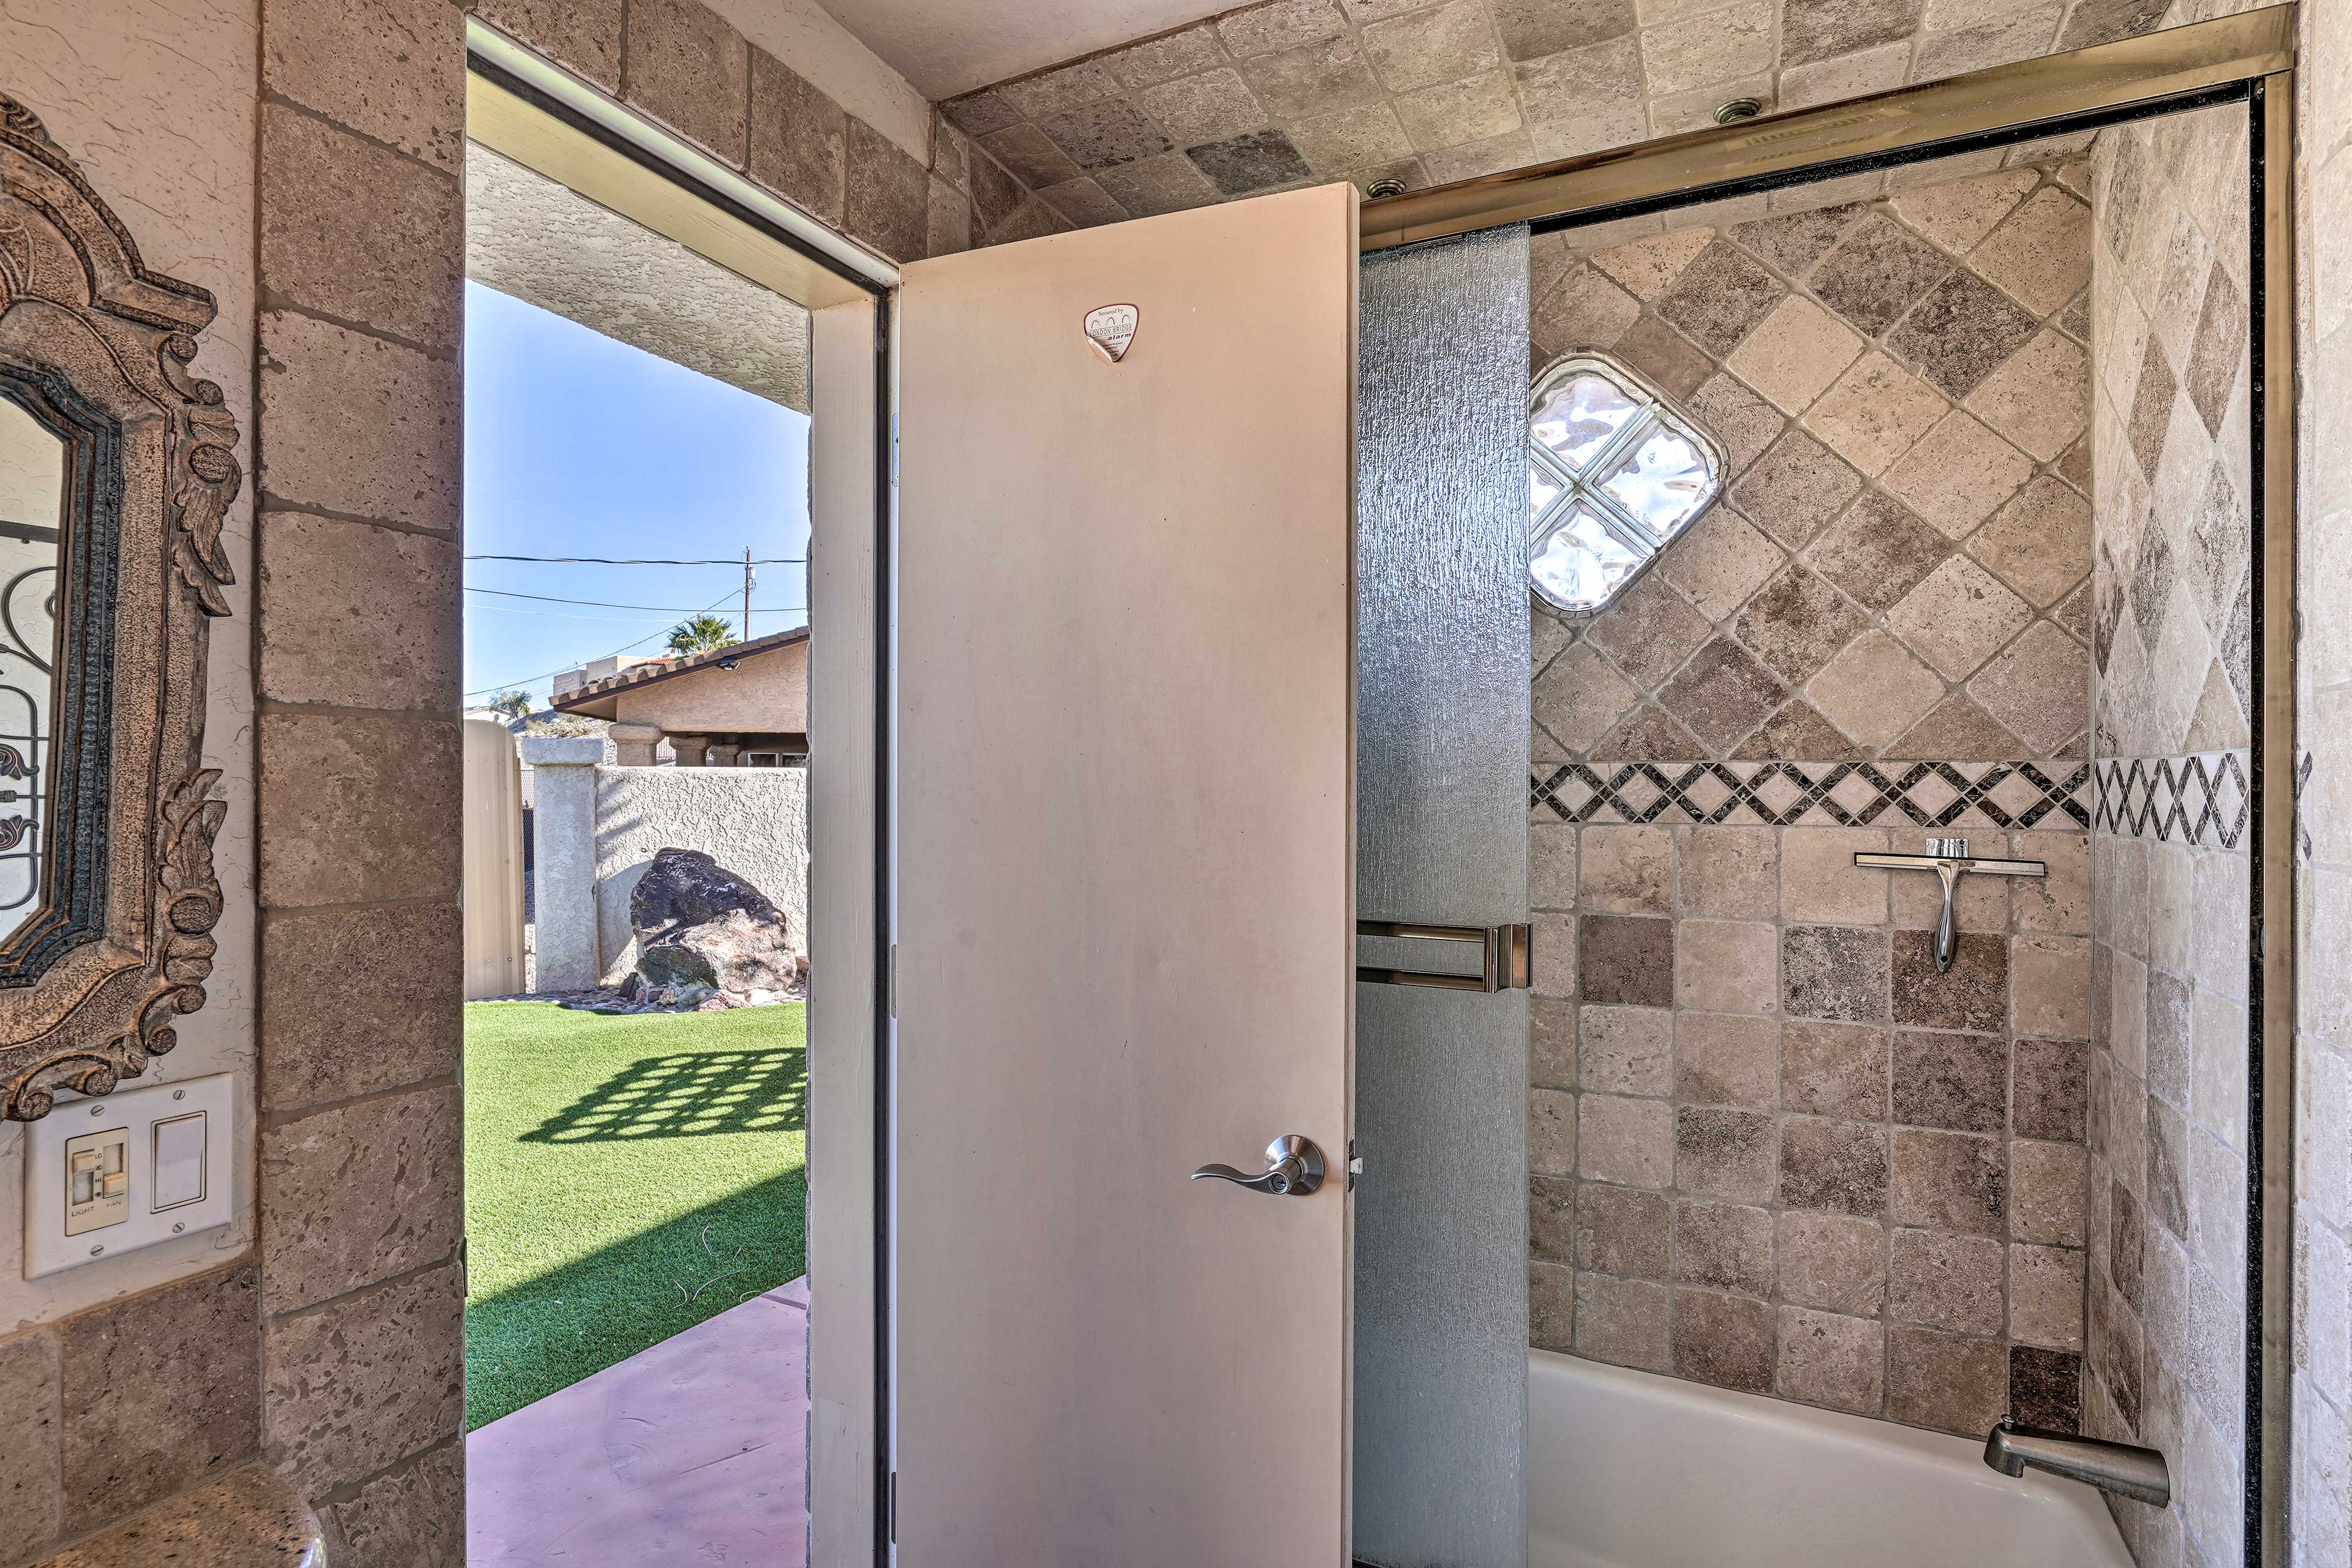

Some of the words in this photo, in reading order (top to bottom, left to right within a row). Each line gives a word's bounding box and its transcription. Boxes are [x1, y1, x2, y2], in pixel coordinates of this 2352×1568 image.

[1090, 328, 1111, 337] LONDON
[1112, 324, 1132, 333] BRIDGE
[71, 1206, 94, 1217] LIGHT
